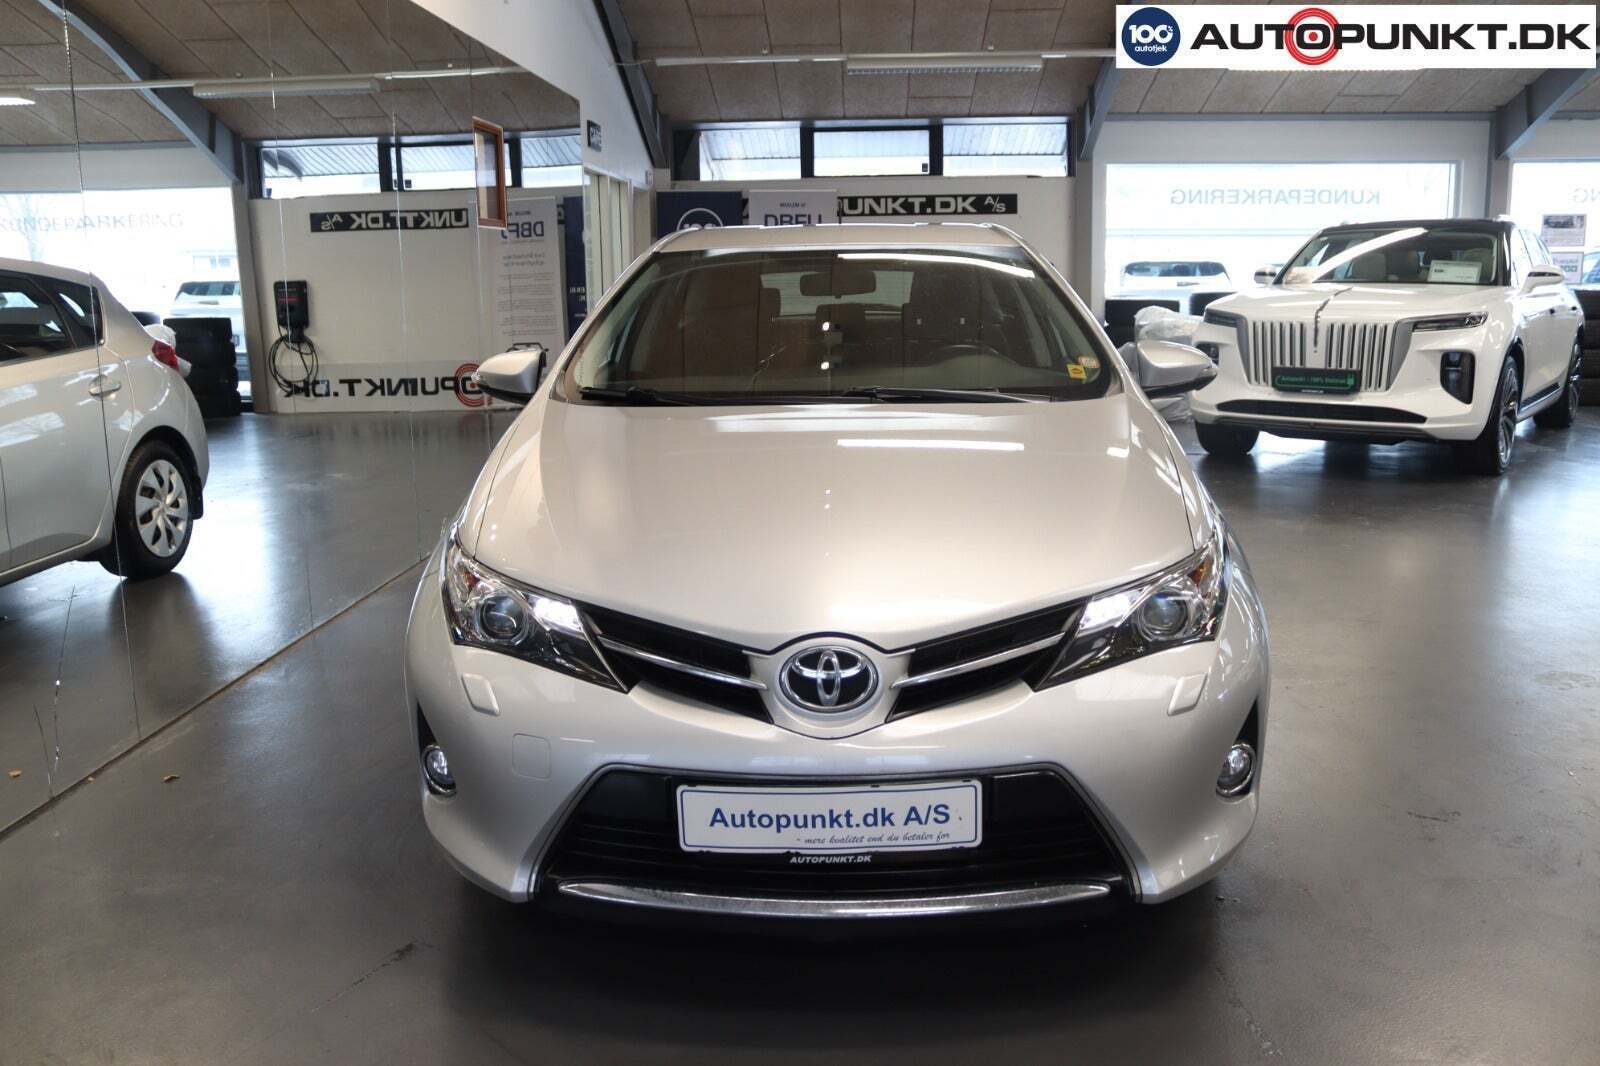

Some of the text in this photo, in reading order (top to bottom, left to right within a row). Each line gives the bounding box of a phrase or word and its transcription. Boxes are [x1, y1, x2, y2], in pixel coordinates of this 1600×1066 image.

[984, 195, 1006, 213] A/S
[709, 804, 950, 833] Autopunkt.dk A/S
[789, 854, 872, 864] AUTOPUNKT.DK
